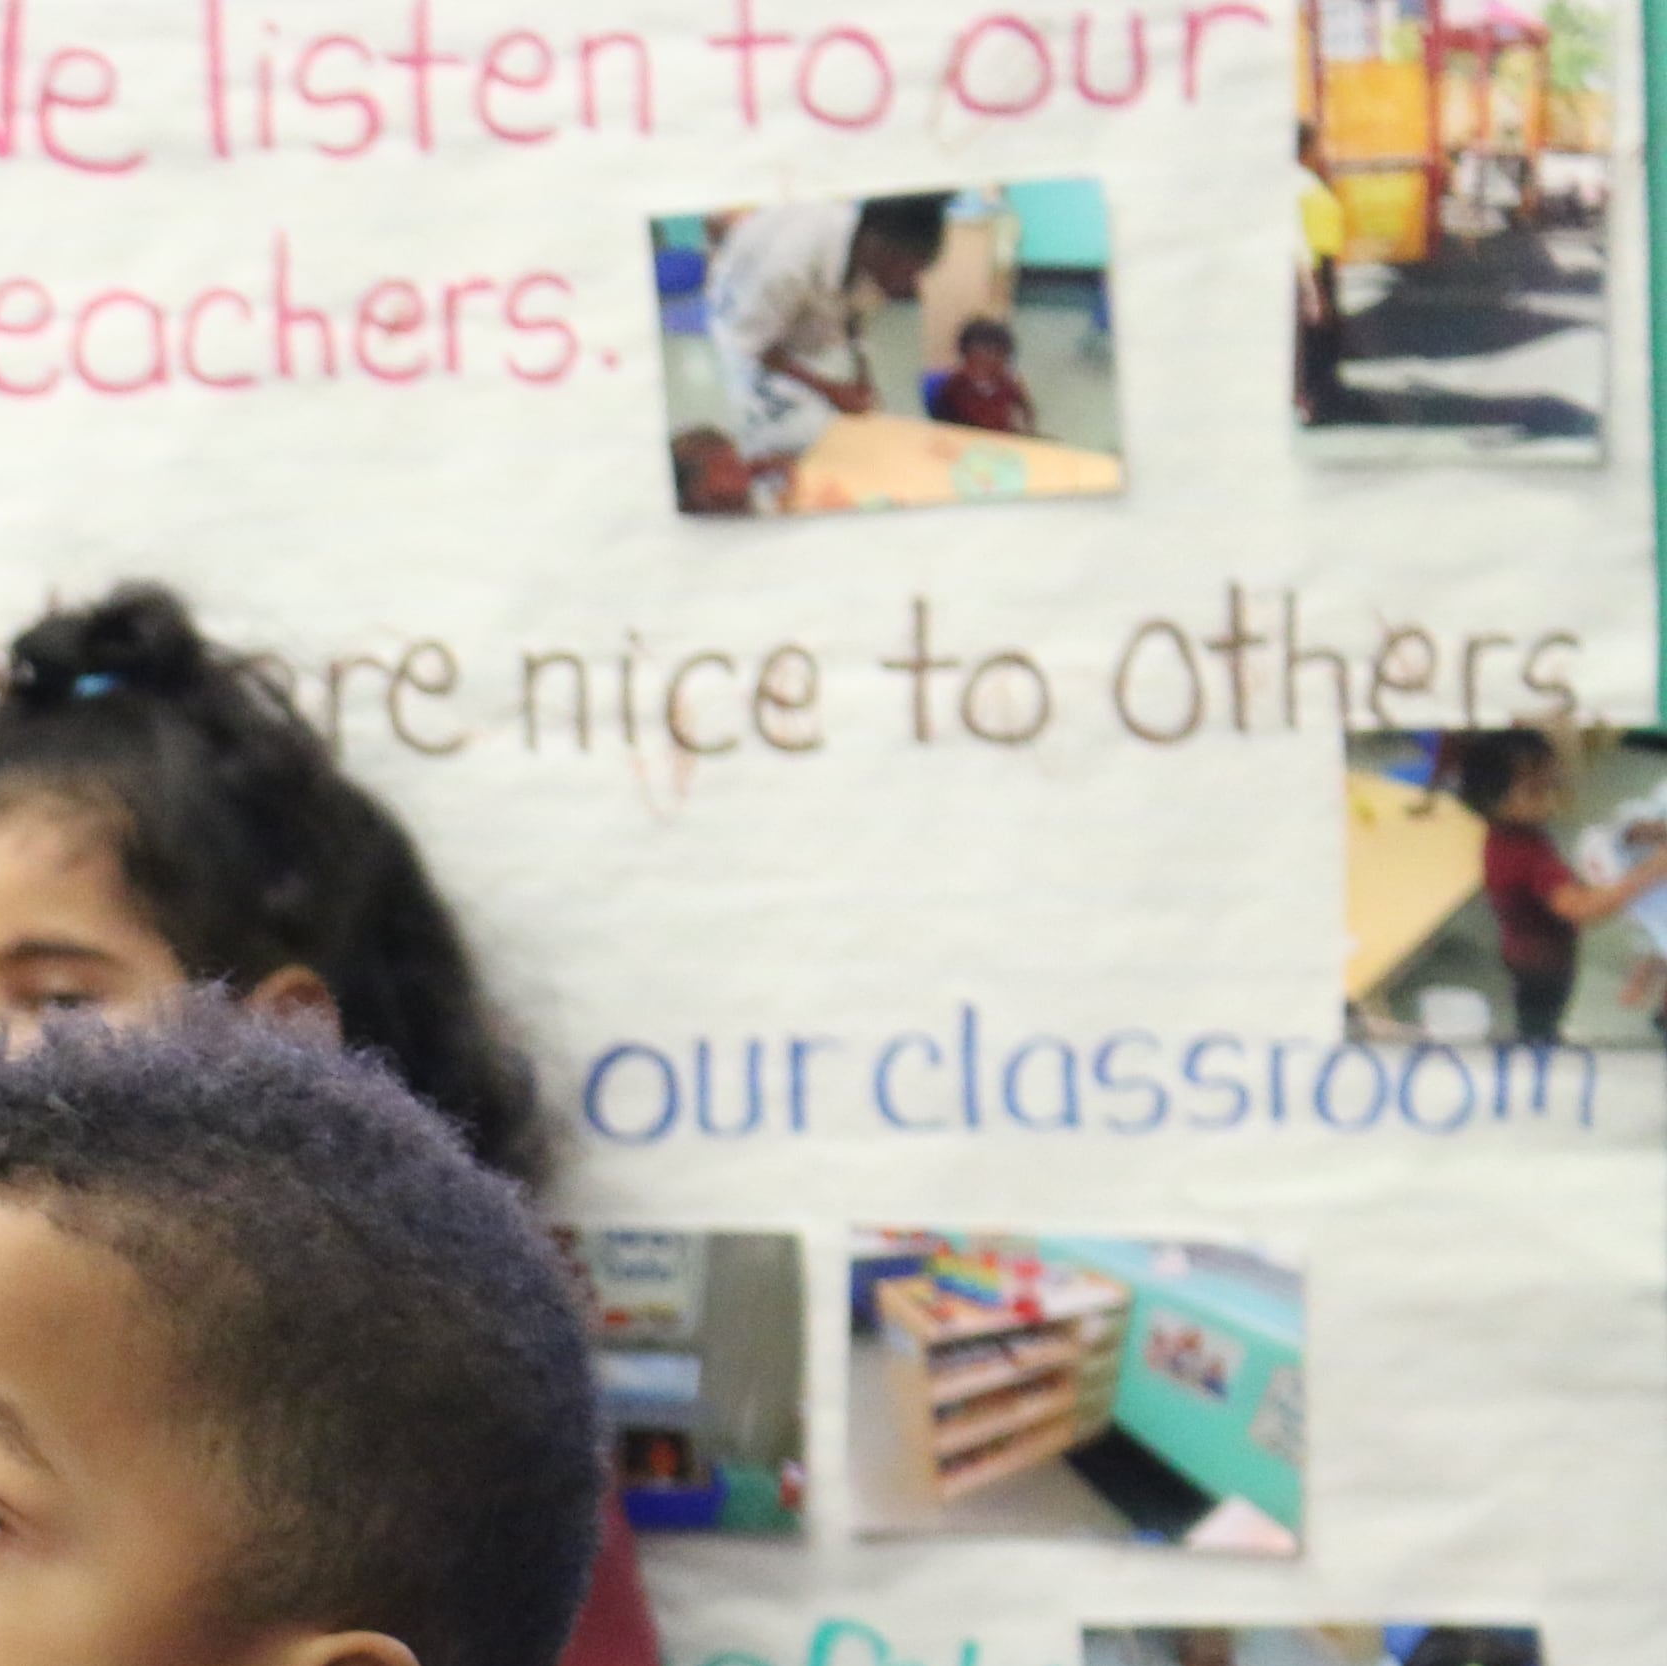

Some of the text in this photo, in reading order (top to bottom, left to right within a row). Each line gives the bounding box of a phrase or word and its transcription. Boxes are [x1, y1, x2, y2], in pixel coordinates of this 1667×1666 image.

[204, 0, 652, 158] listen
[708, 0, 895, 130] to
[947, 2, 1270, 118] our
[520, 627, 824, 760] nice
[880, 594, 1052, 744] to
[583, 1000, 1597, 1149] our classroom
